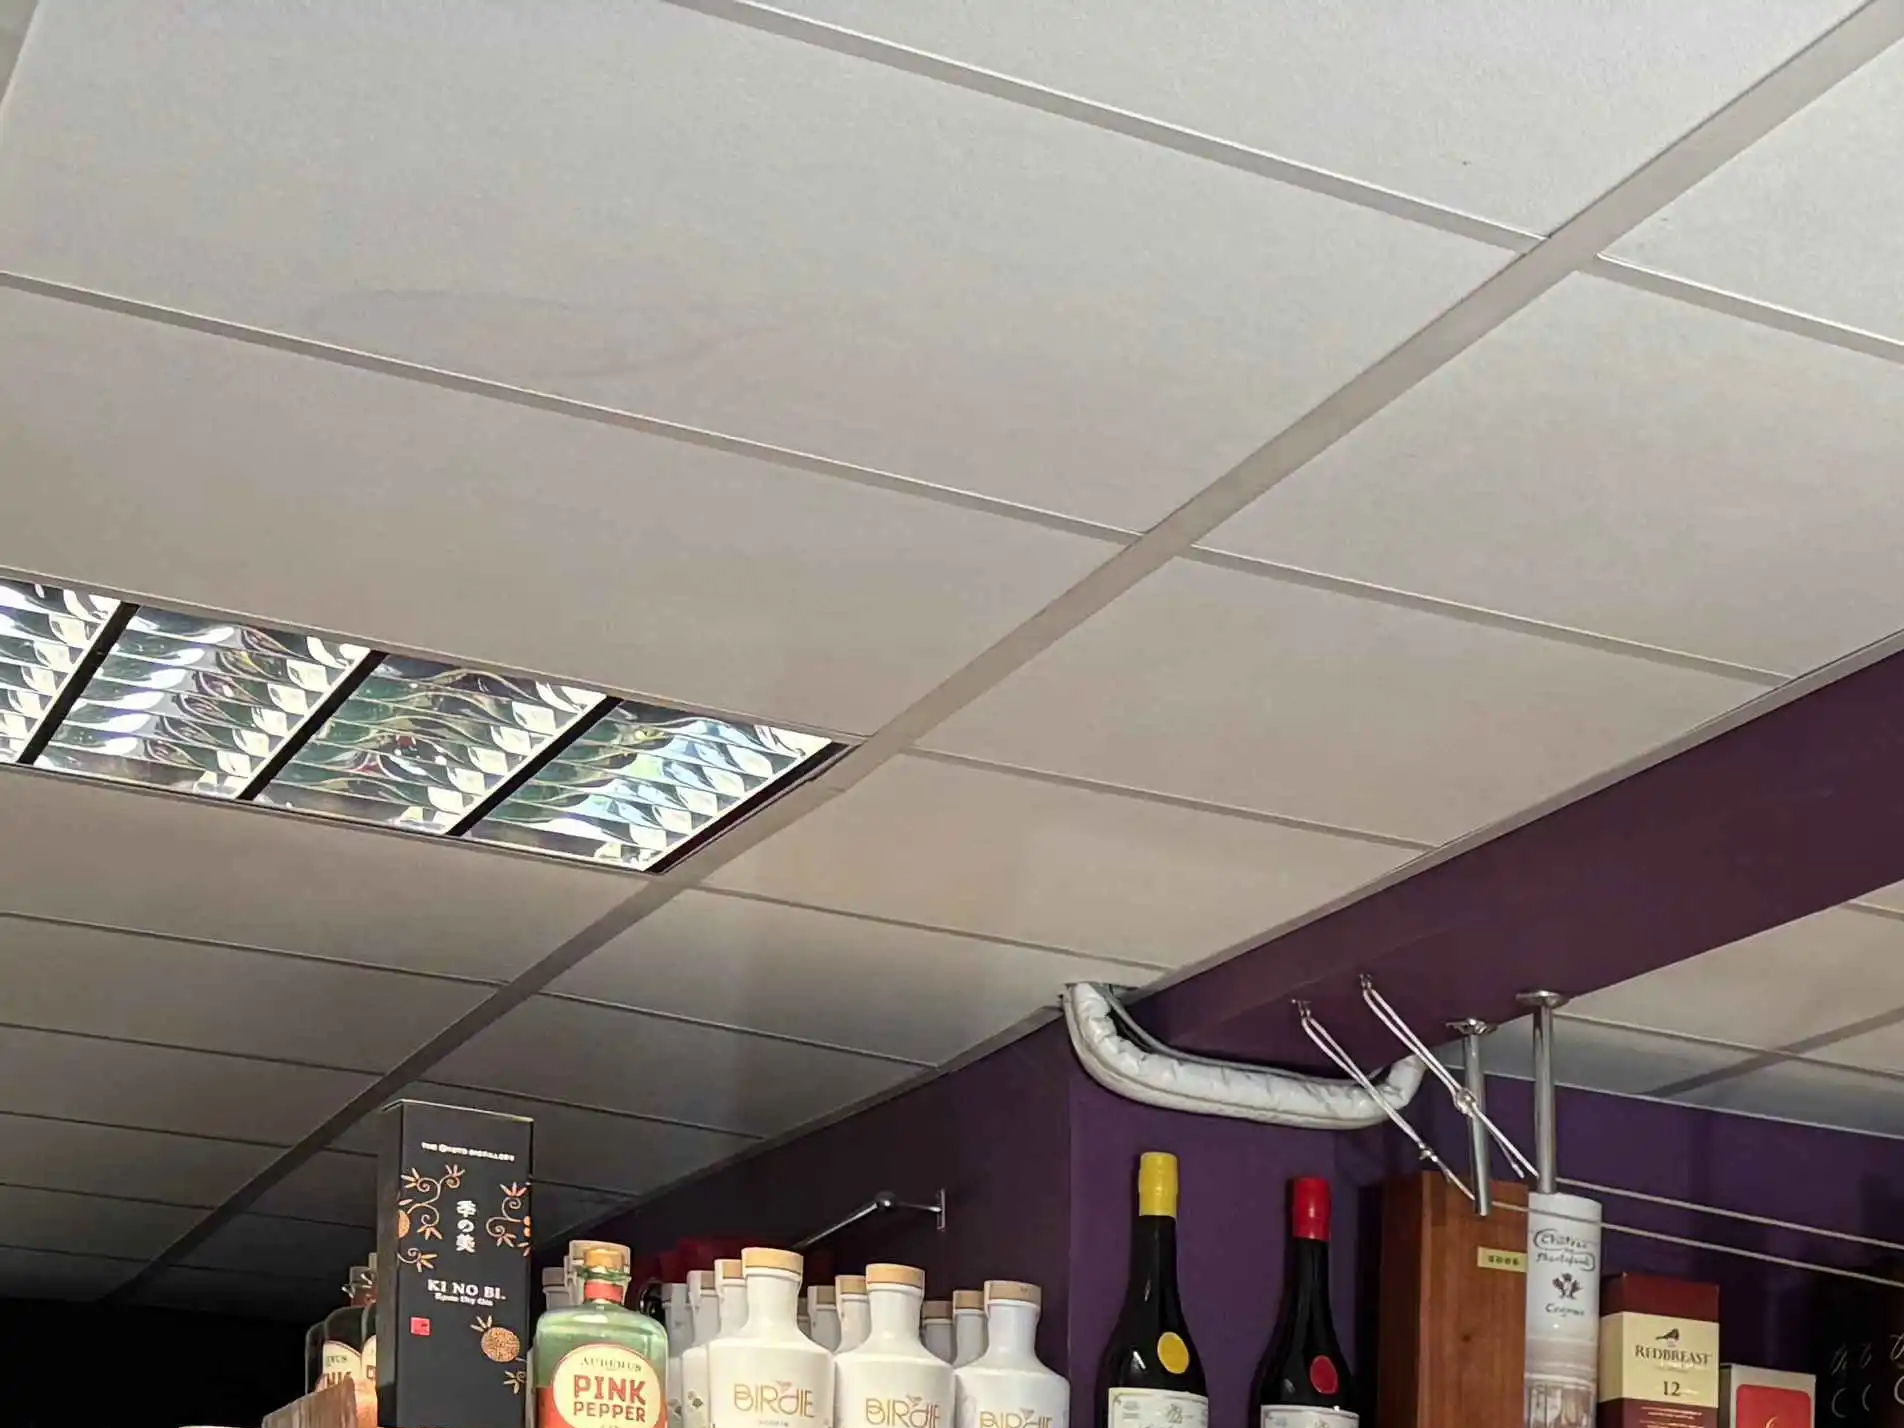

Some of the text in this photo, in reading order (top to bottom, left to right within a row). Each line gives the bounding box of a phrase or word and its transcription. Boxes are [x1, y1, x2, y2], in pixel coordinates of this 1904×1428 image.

[428, 1279, 451, 1293] KI
[454, 1282, 480, 1296] NO
[1635, 1345, 1711, 1368] REDBREAST
[573, 1375, 647, 1405] PINK
[1662, 1380, 1681, 1398] 12
[573, 1401, 647, 1423] PEPPER
